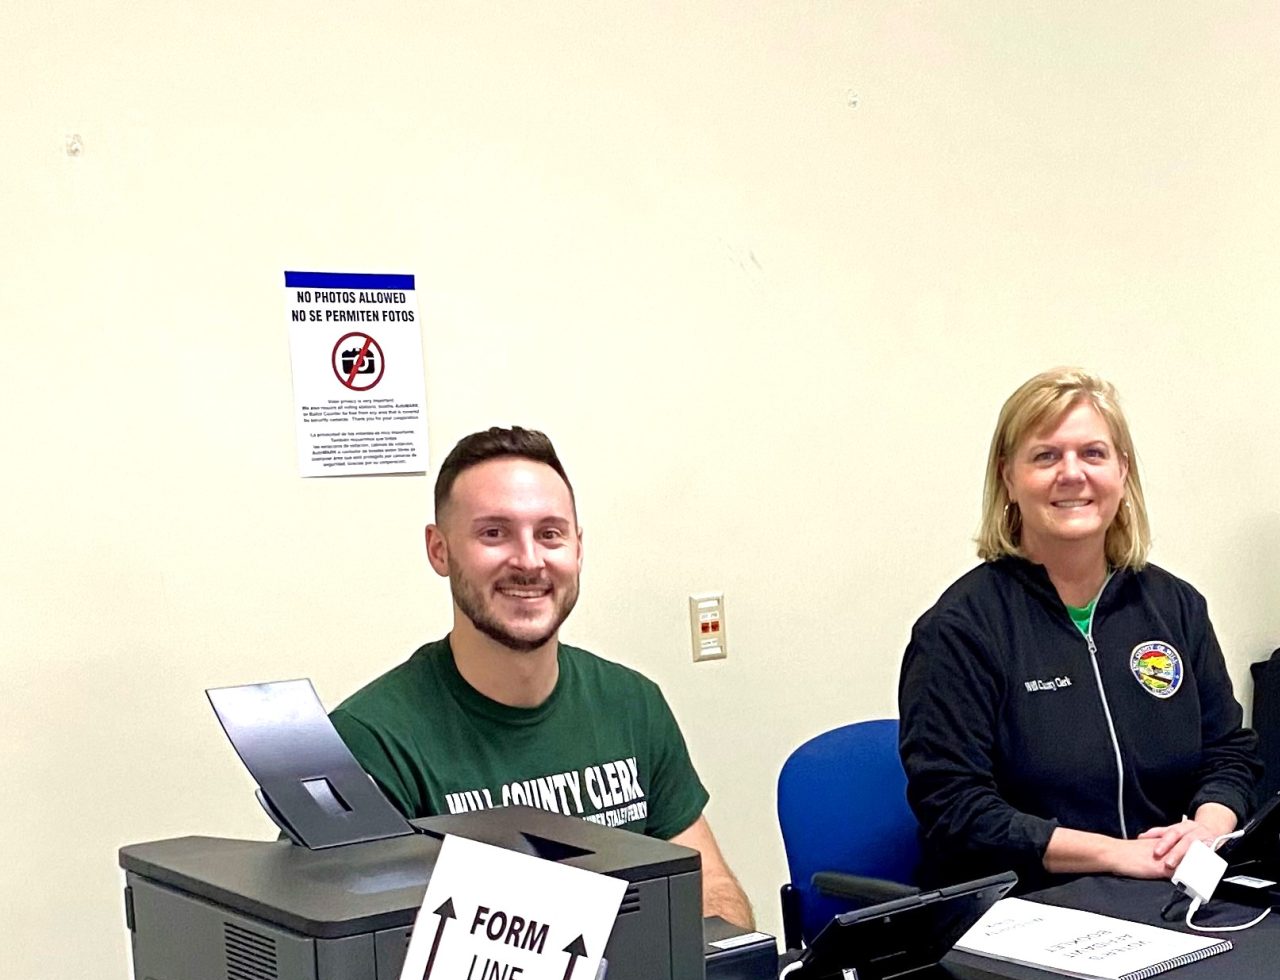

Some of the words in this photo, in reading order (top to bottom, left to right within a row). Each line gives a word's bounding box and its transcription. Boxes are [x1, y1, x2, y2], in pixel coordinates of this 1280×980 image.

[297, 291, 312, 303] NO
[314, 291, 356, 304] PHOTOS
[359, 292, 406, 304] ALLOWED
[291, 310, 306, 321] NO
[309, 310, 323, 322] SE
[326, 310, 380, 322] PERMITEN
[382, 310, 415, 322] FOTOS
[584, 756, 645, 810] CLERK
[470, 905, 550, 955] FORM
